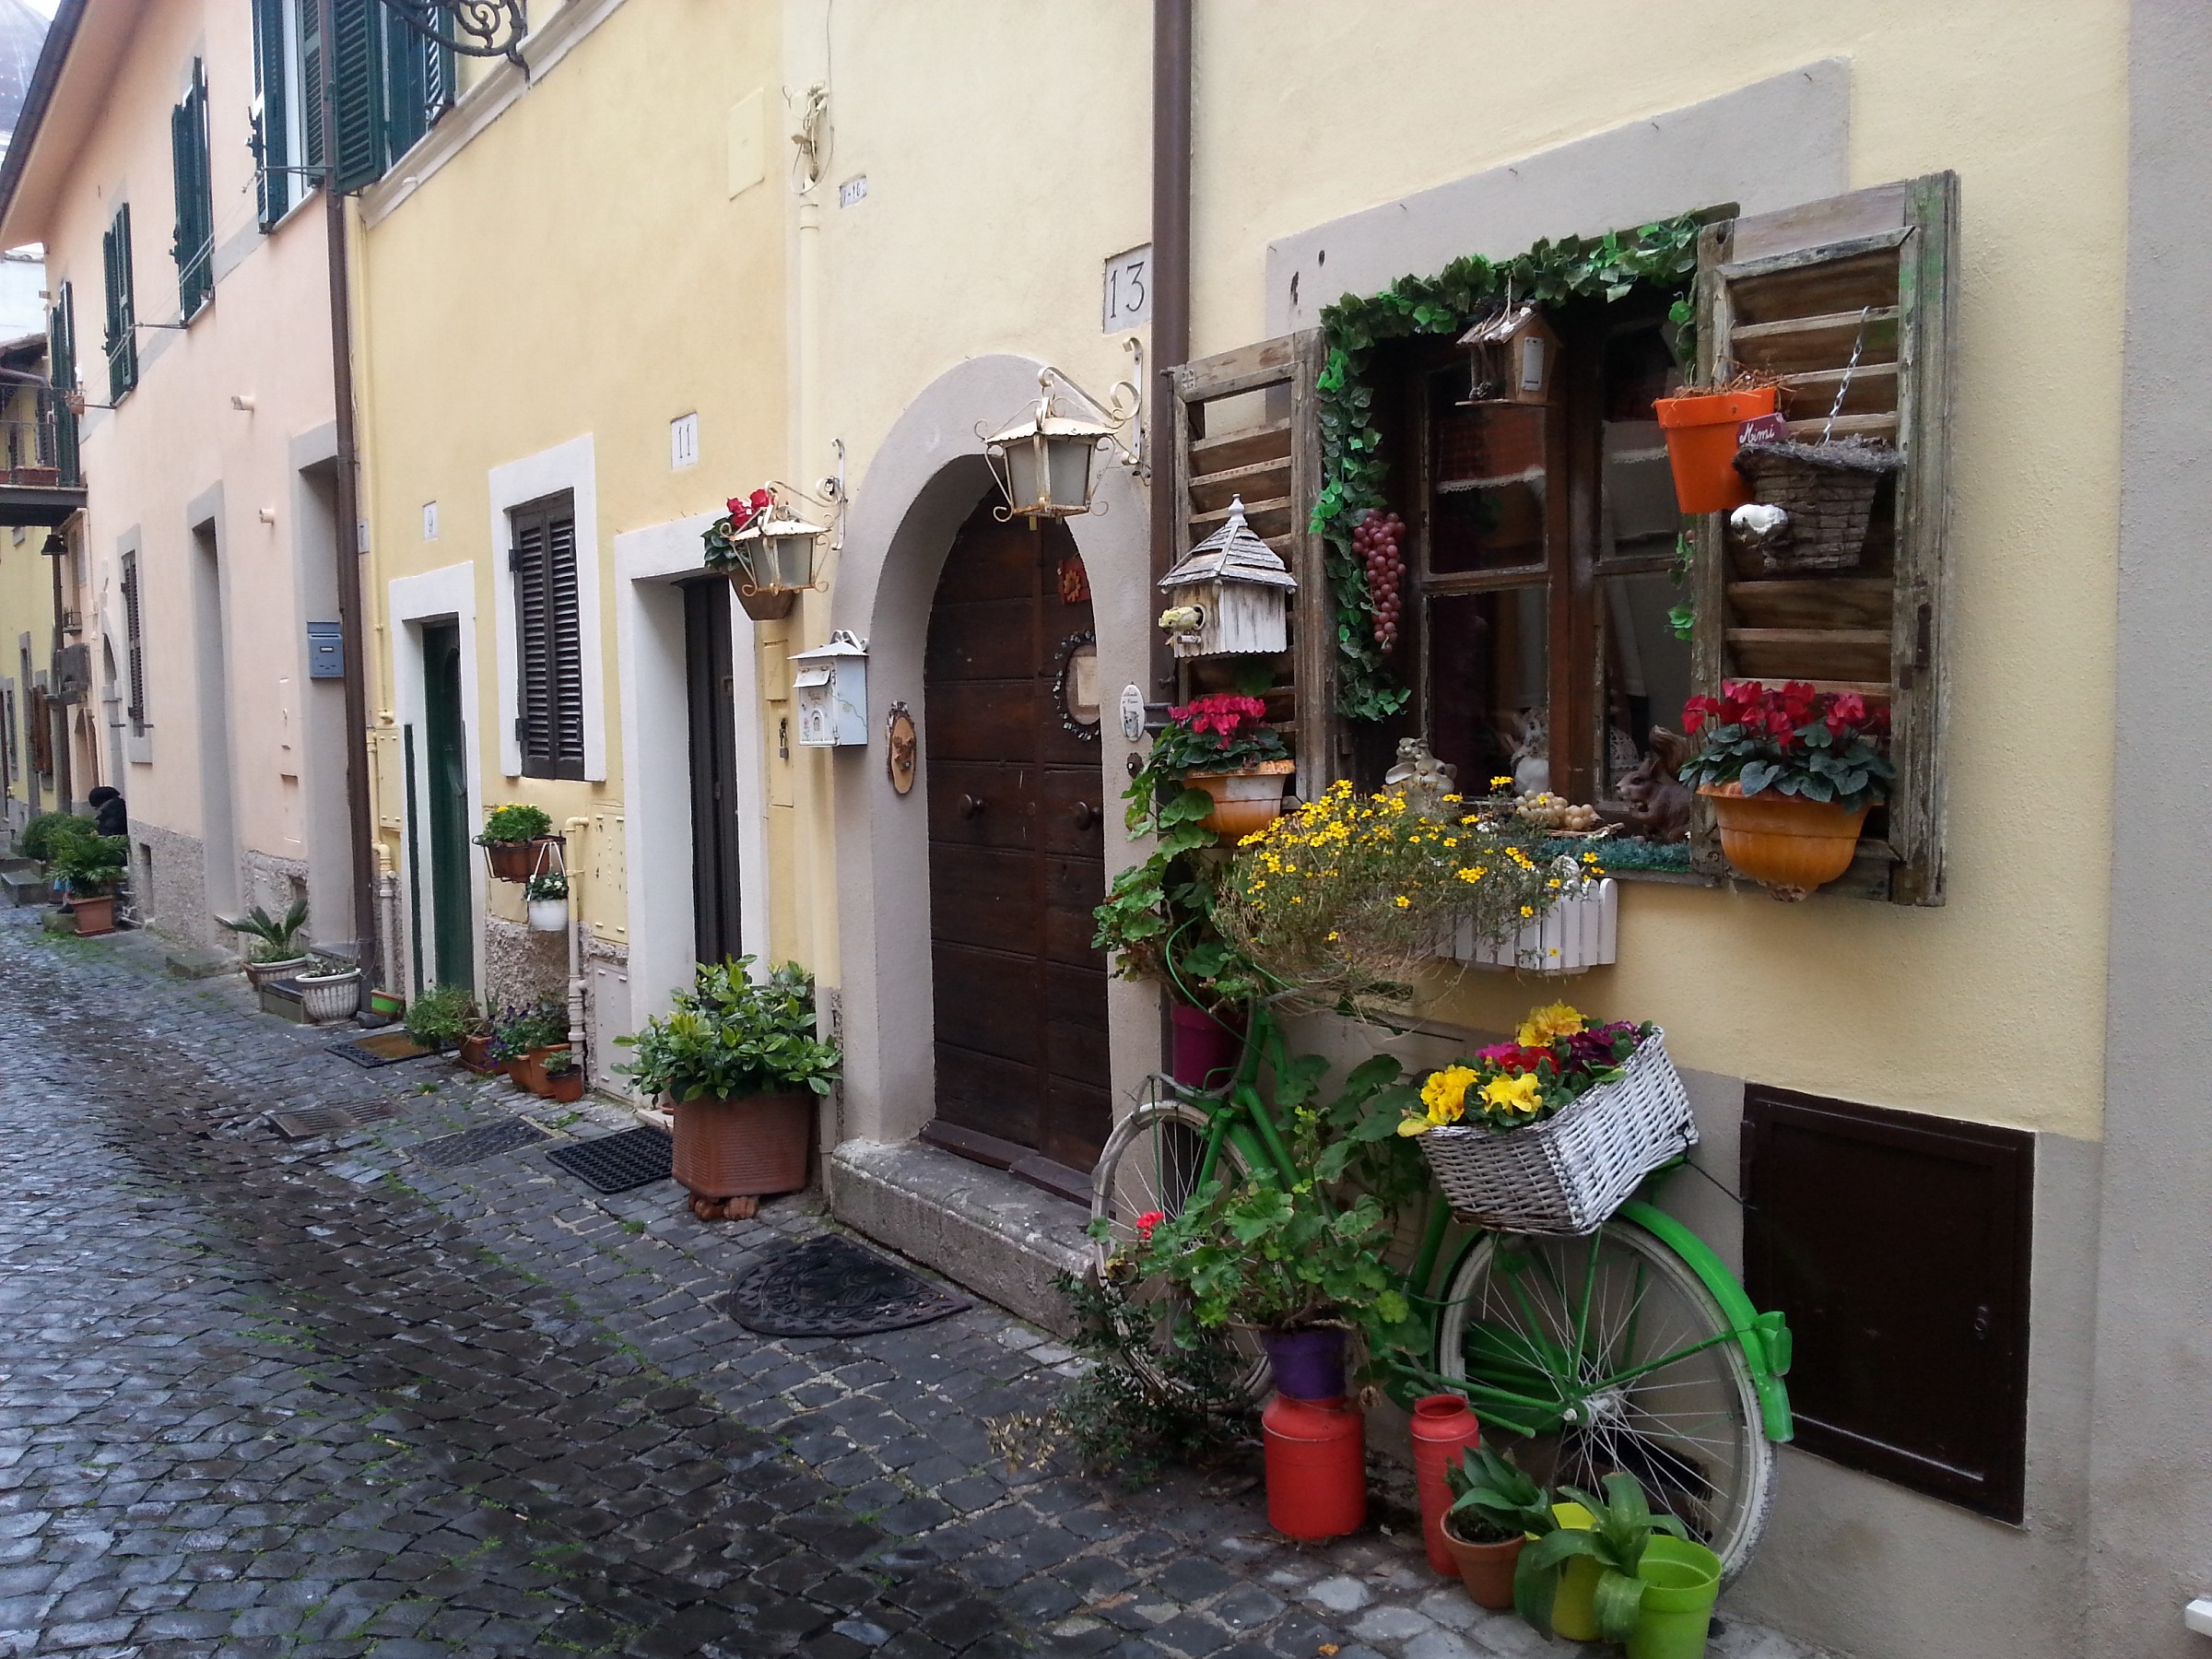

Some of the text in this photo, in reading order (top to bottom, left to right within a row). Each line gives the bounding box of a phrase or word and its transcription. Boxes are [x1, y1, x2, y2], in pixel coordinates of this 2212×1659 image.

[1110, 261, 1145, 319] 13
[677, 423, 691, 459] 11
[1739, 422, 1775, 444] Mimi
